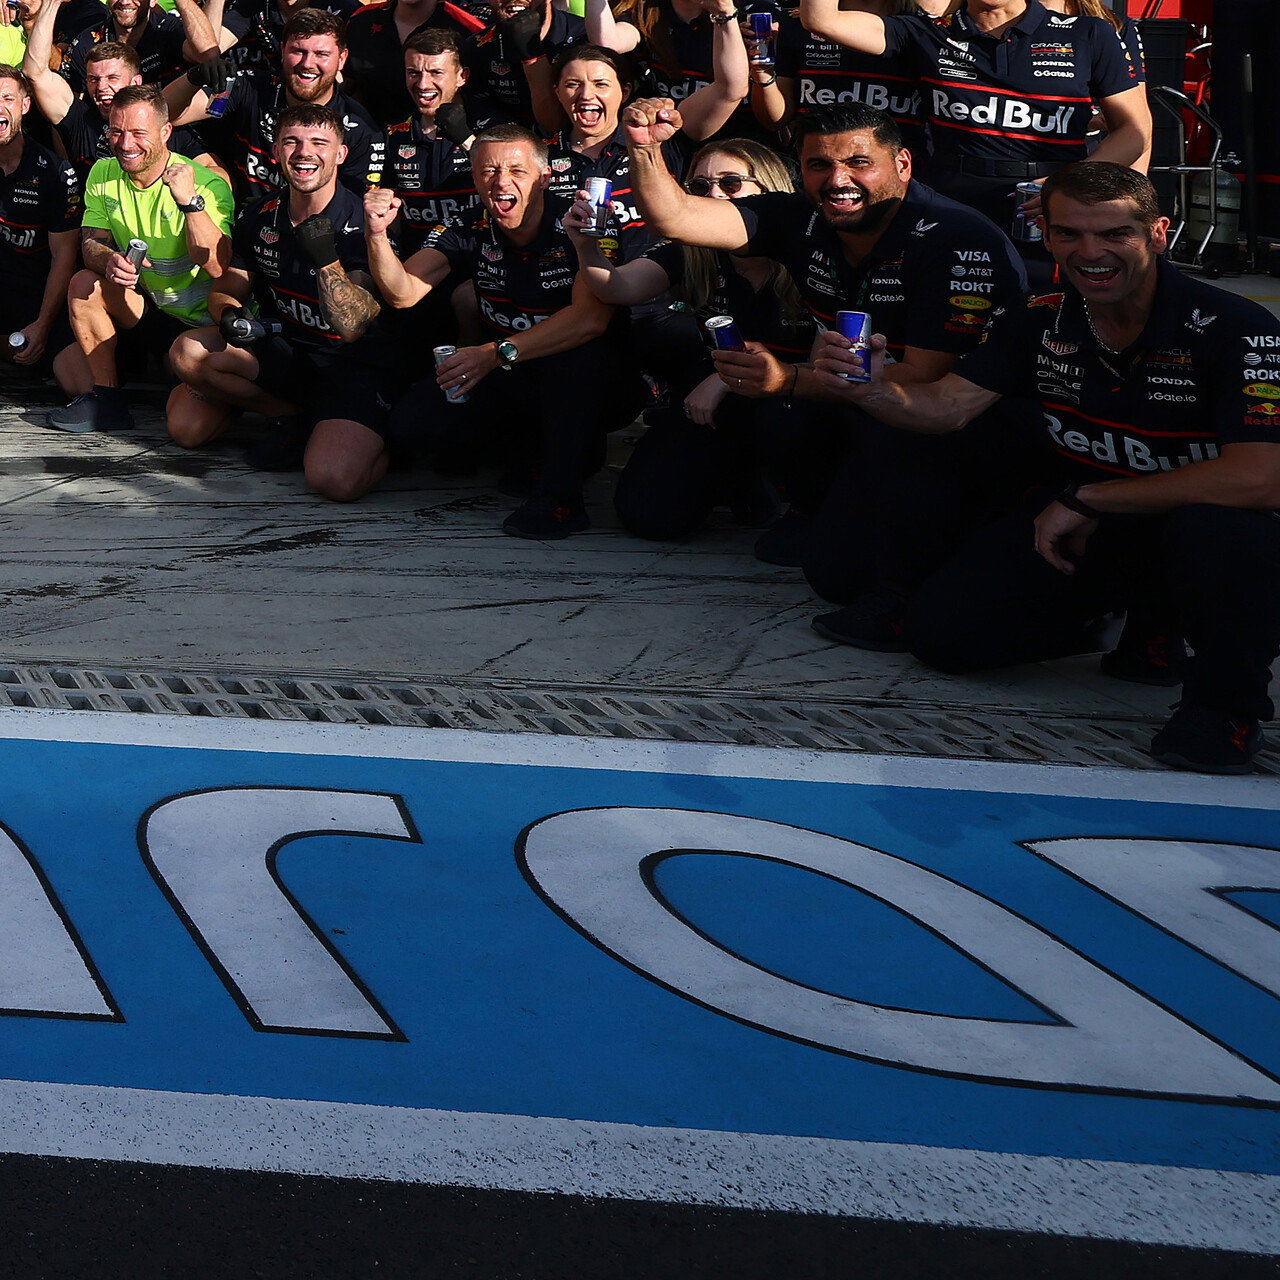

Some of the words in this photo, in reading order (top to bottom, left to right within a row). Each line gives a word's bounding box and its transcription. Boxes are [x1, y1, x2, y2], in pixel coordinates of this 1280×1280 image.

[1042, 70, 1075, 78] Gate.io
[656, 79, 689, 100] ed
[800, 78, 862, 105] Red
[932, 89, 998, 124] Red
[1001, 99, 1075, 134] Bull
[14, 188, 39, 196] HONDA
[253, 246, 273, 257] Mobil
[953, 250, 991, 262] VISA
[540, 267, 571, 277] HONDA
[808, 264, 832, 279] ORA
[968, 267, 994, 277] AT&T
[950, 280, 994, 293] ROKT
[875, 293, 905, 302] Gate.io
[1152, 392, 1197, 402] Gate.io
[1043, 411, 1117, 464] Red
[1123, 436, 1219, 472] Bull
